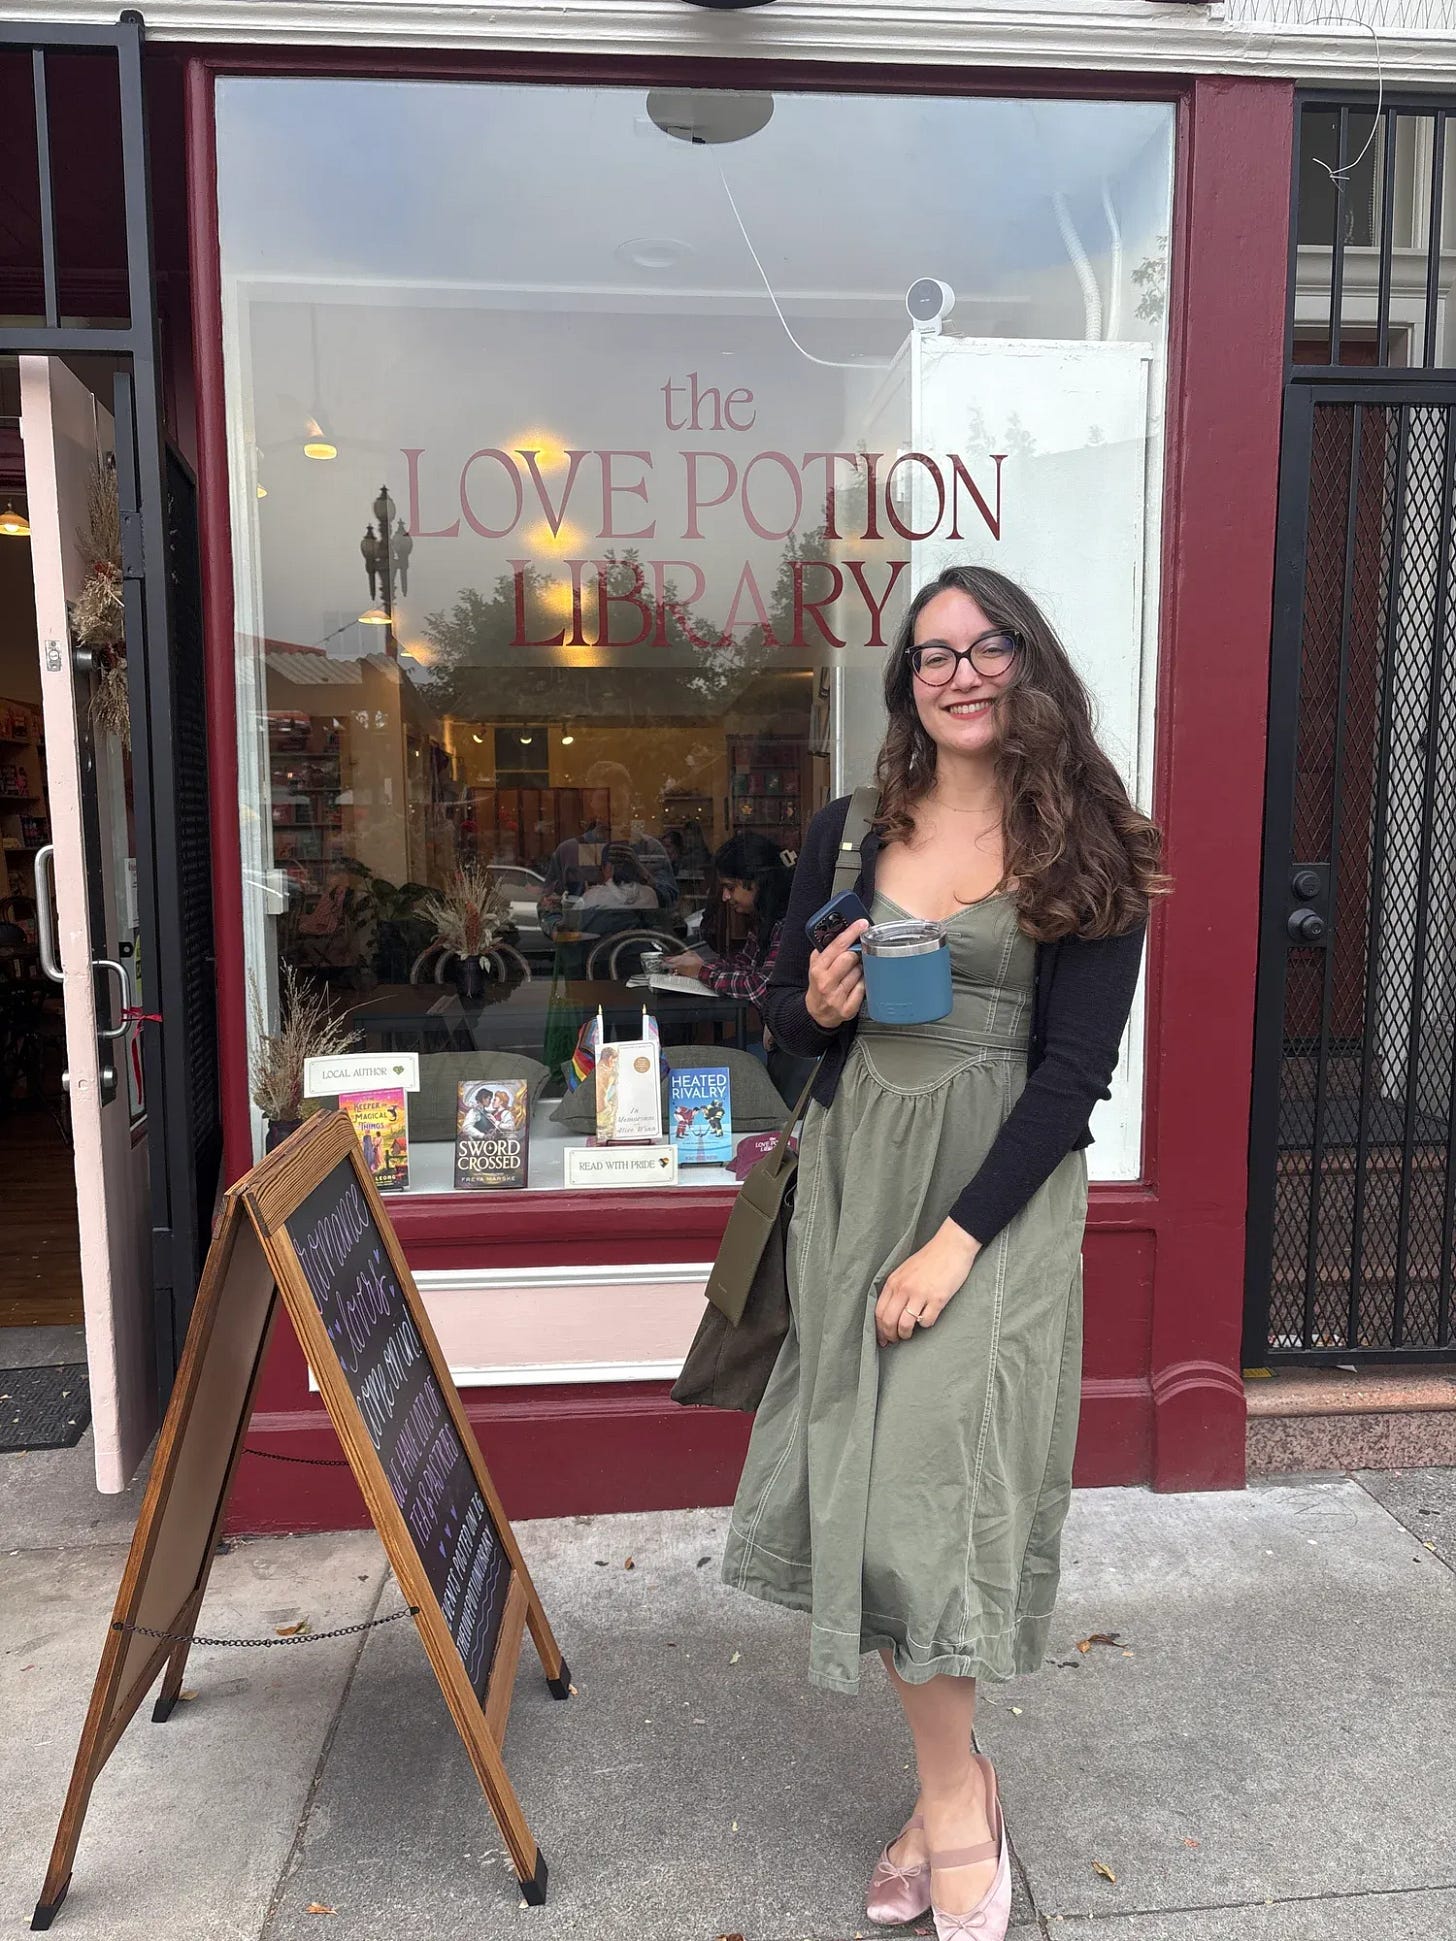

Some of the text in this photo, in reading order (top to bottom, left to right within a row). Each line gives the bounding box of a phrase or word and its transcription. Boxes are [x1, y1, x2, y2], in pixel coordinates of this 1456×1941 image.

[660, 371, 756, 432] the
[400, 448, 1009, 542] LOVE POTION
[506, 558, 913, 649] LIBRARY
[322, 1066, 388, 1080] LOCAL AUTHOR
[671, 1074, 727, 1088] HEATED
[672, 1086, 726, 1099] RIVALRY
[353, 1112, 388, 1123] MAGICAL
[358, 1122, 385, 1132] THINGS
[458, 1139, 521, 1157] SWORD
[457, 1156, 521, 1172] CROSSED
[579, 1159, 656, 1171] READ WITH PRIDE
[293, 1184, 369, 1314] romance
[336, 1259, 390, 1373] lovers
[356, 1304, 423, 1451] come on in!
[386, 1375, 441, 1510] WE HAVE LOTS OF
[409, 1423, 459, 1549] TEA & PASTRIES
[441, 1492, 484, 1631] EVENTS POSTED ON IG
[456, 1524, 494, 1662] THELOVEPOTIONLIBRARY
